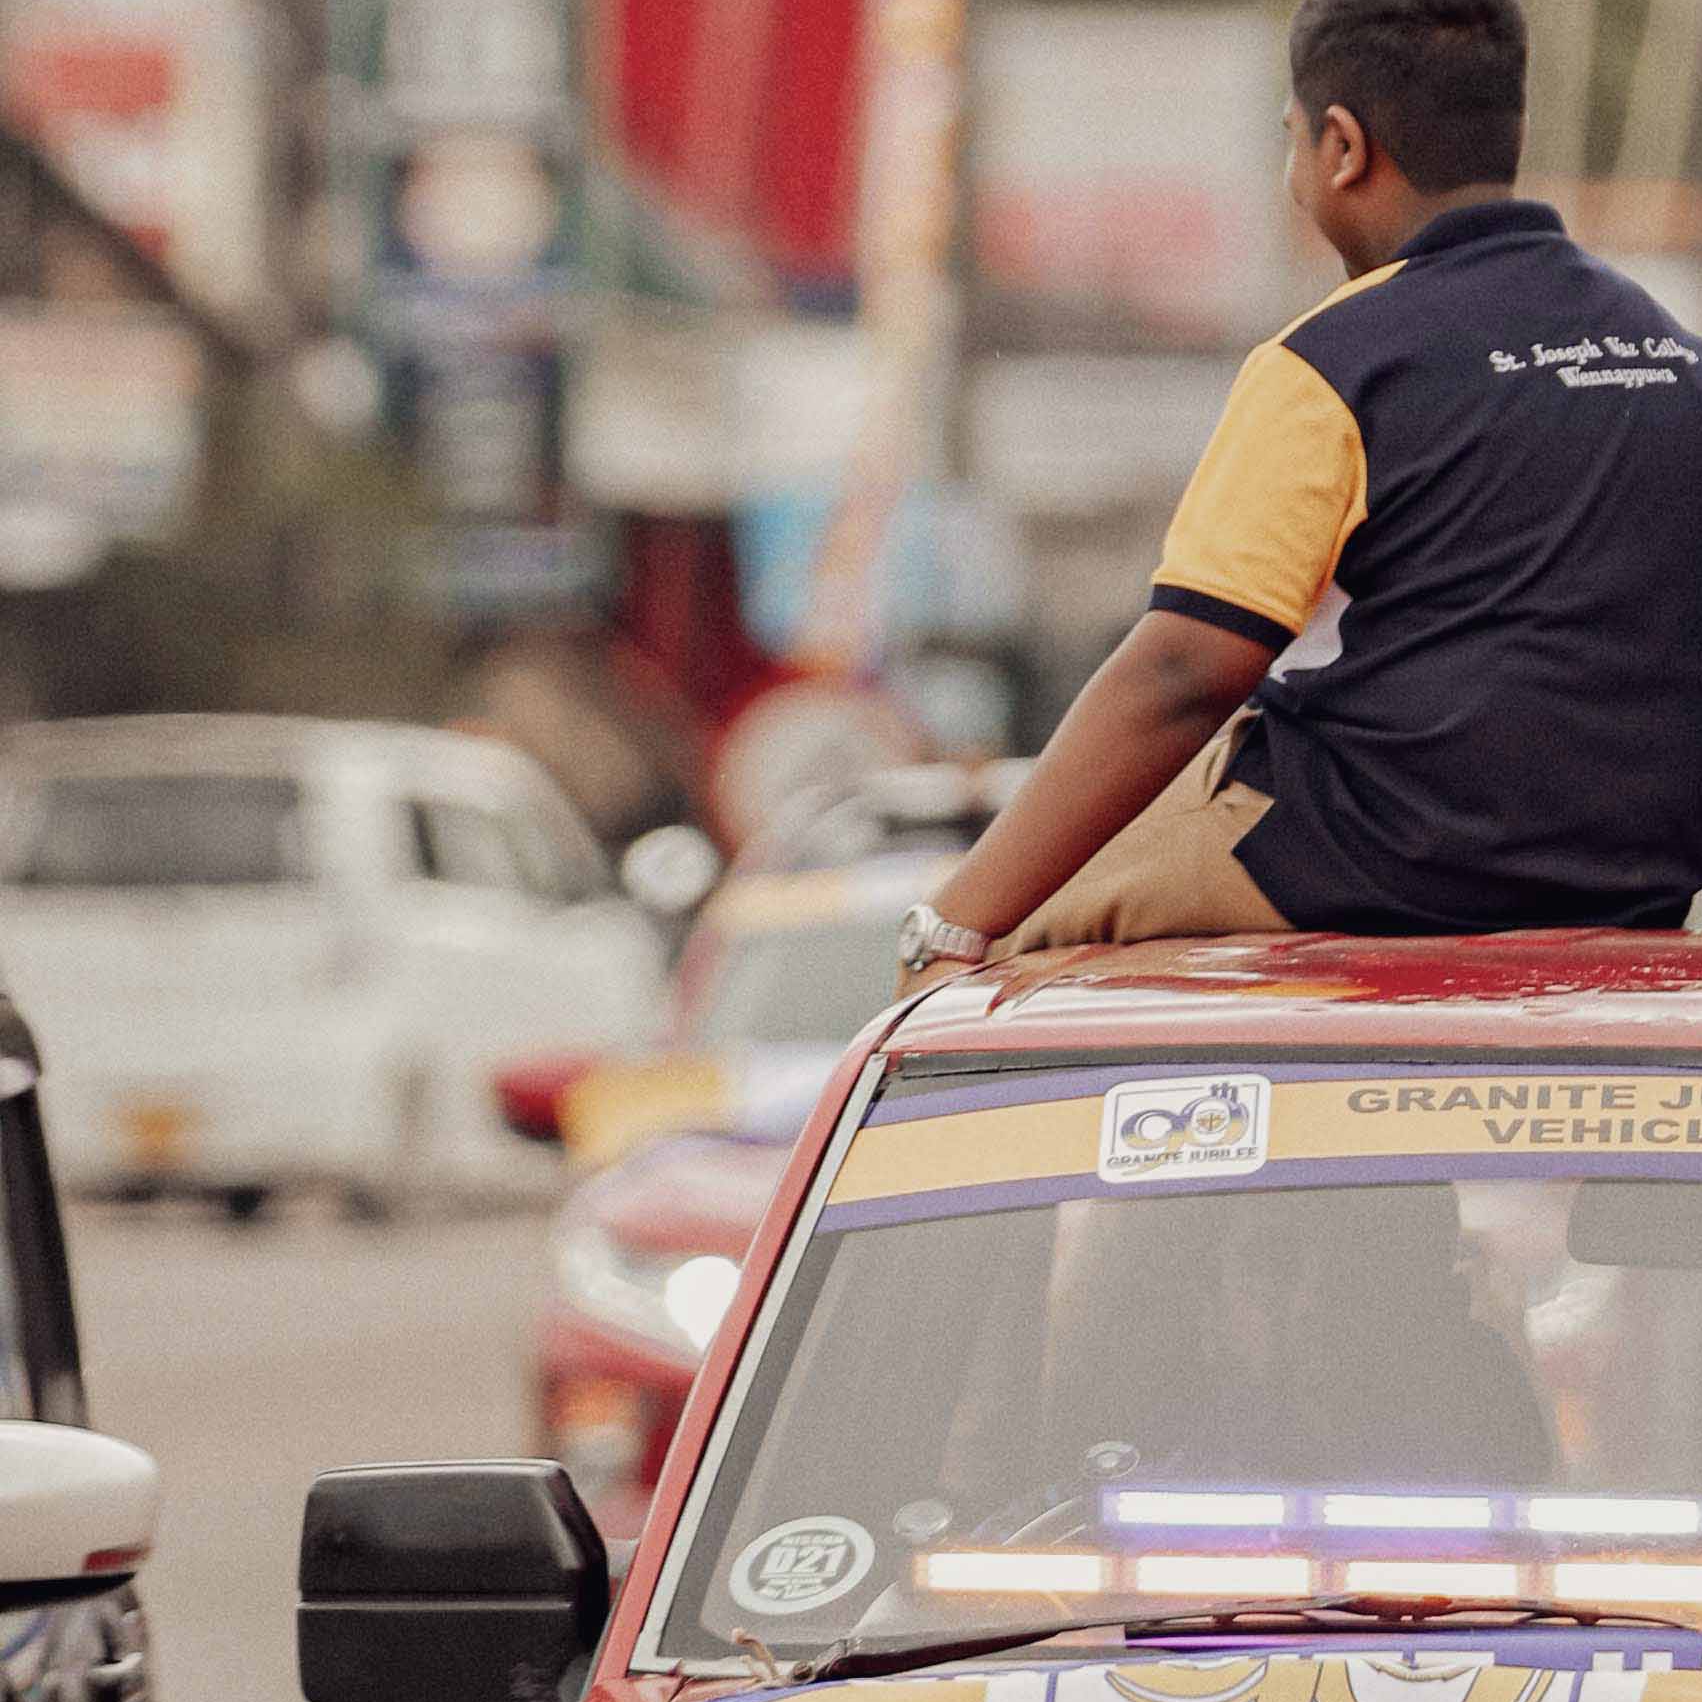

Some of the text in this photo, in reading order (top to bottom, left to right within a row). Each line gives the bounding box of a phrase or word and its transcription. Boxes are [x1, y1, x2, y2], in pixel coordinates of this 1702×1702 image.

[1489, 350, 1527, 372] St.
[1530, 337, 1603, 367] Joseph
[1642, 336, 1699, 364] Coll
[1556, 365, 1677, 388] Wennappuwa
[1347, 1084, 1638, 1113] GRANITE
[1107, 1147, 1258, 1168] GRANITE JUBILEE
